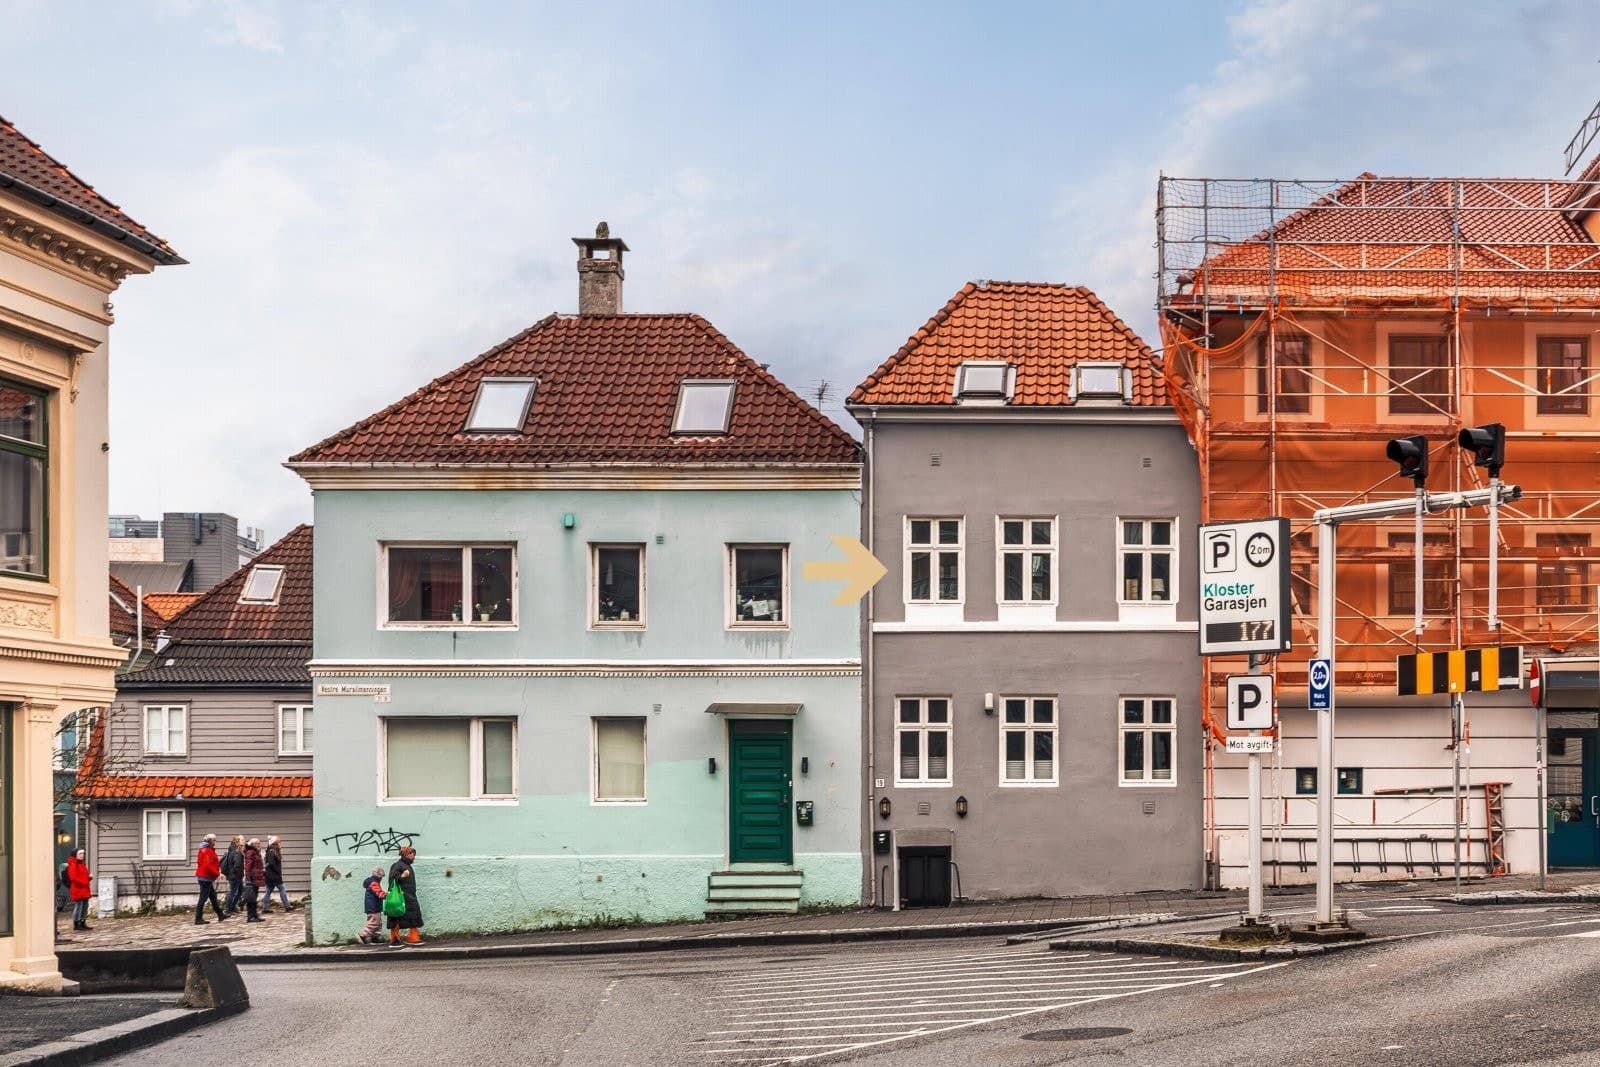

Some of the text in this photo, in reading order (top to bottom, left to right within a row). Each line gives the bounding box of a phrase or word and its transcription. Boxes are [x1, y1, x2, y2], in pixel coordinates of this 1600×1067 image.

[1213, 541, 1230, 568] P
[1204, 582, 1255, 597] Kloster
[1204, 596, 1267, 612] Garasjen
[1240, 621, 1273, 640] 177
[1238, 684, 1261, 721] P
[1229, 740, 1269, 750] Mot avgift
